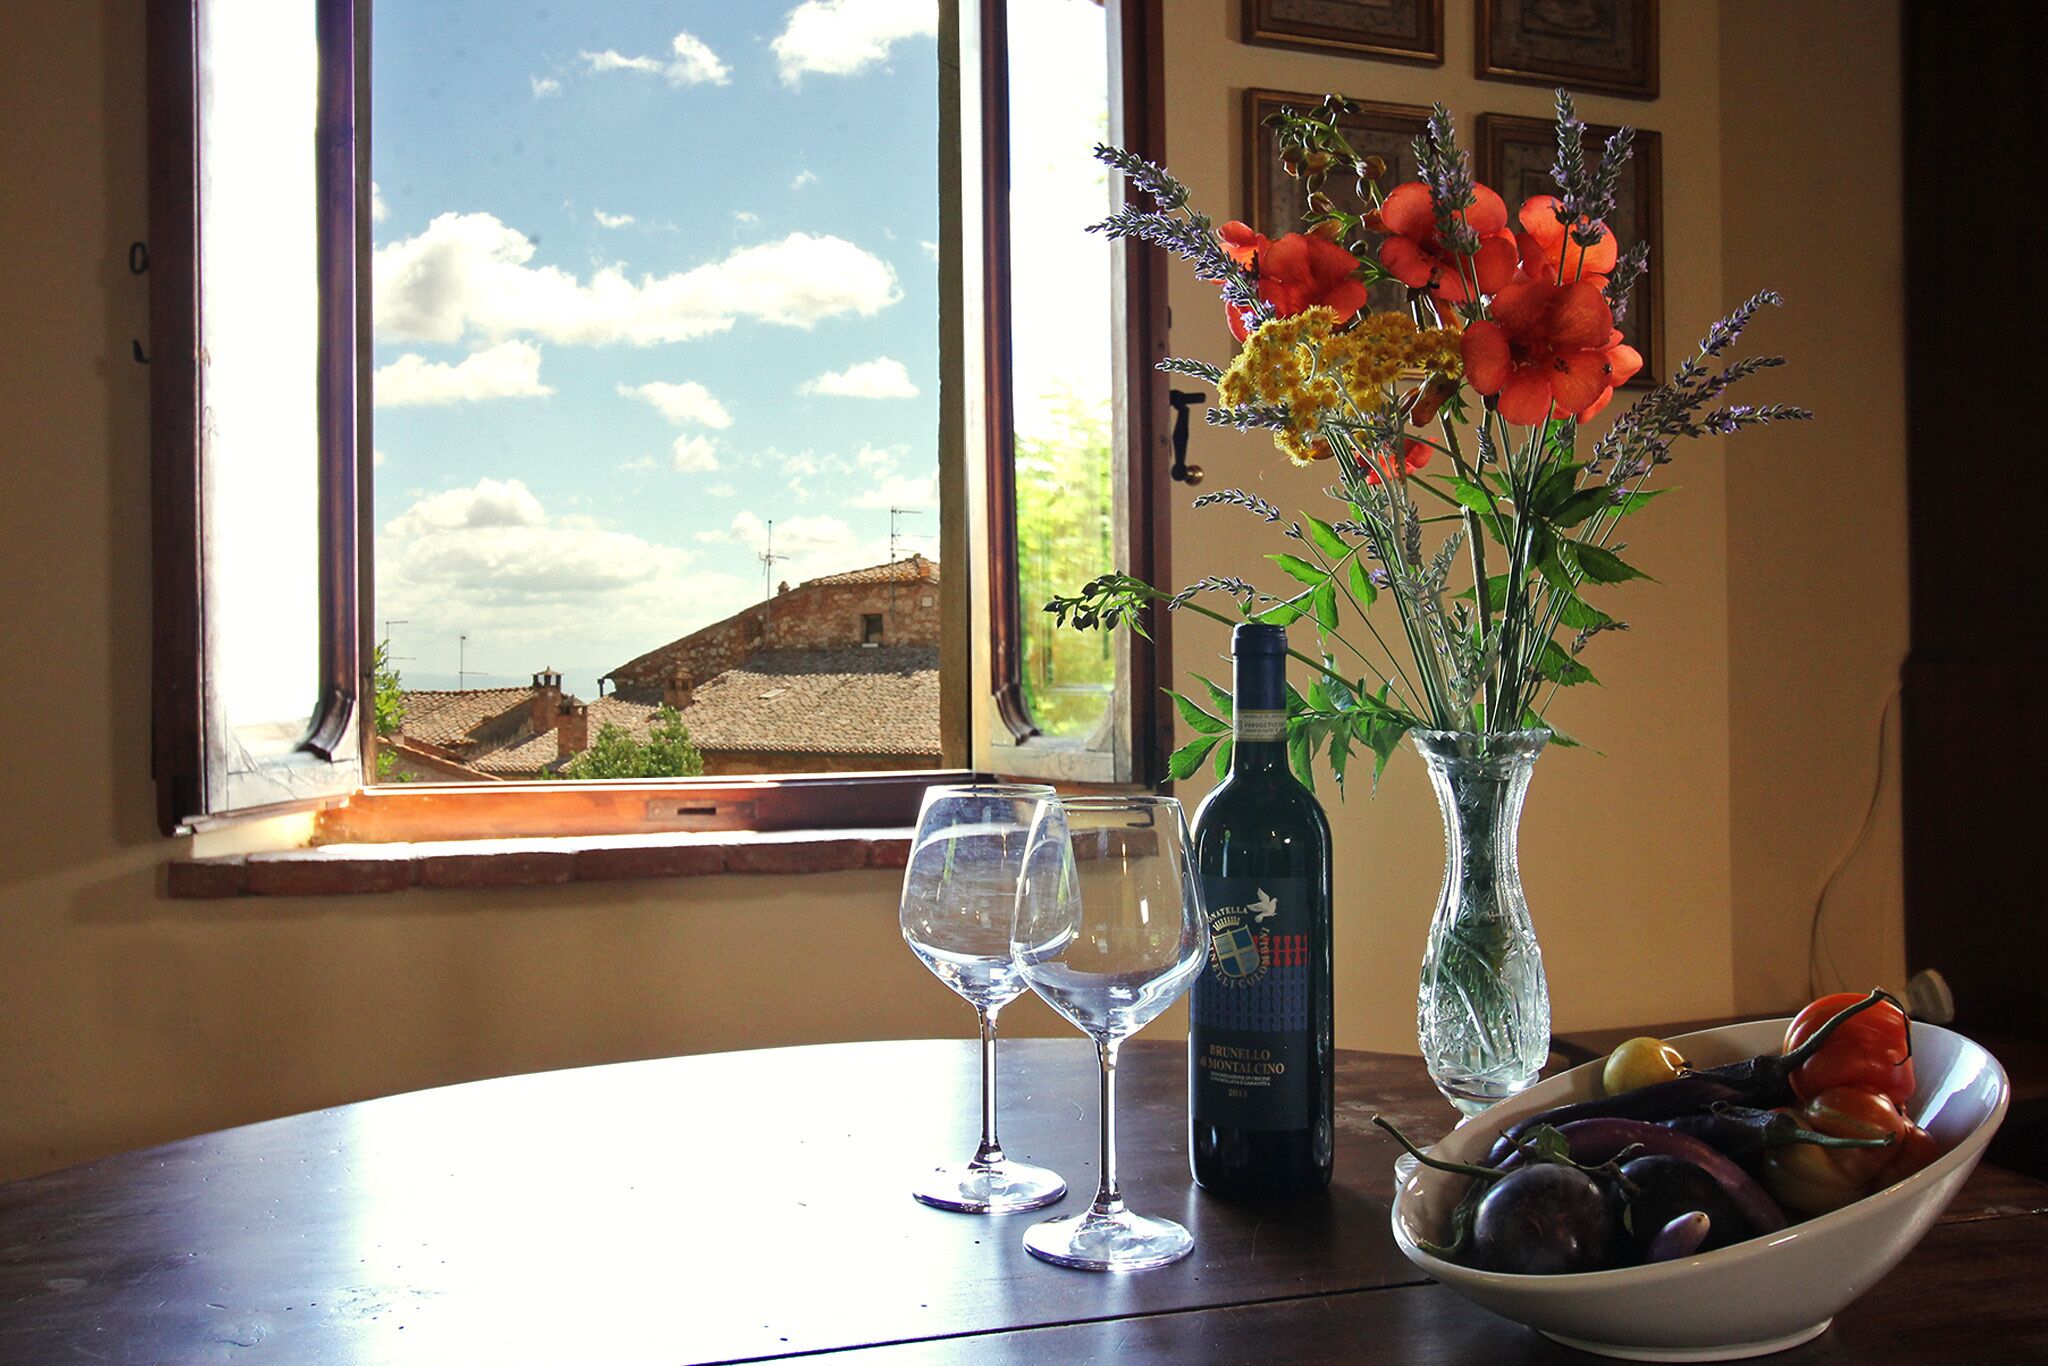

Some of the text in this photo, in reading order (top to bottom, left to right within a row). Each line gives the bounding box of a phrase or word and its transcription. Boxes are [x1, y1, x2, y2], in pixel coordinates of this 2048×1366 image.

[1208, 906, 1249, 923] ONATELLA
[1209, 1044, 1271, 1061] BRUNELLO
[1208, 1058, 1285, 1074] MONTALCINO
